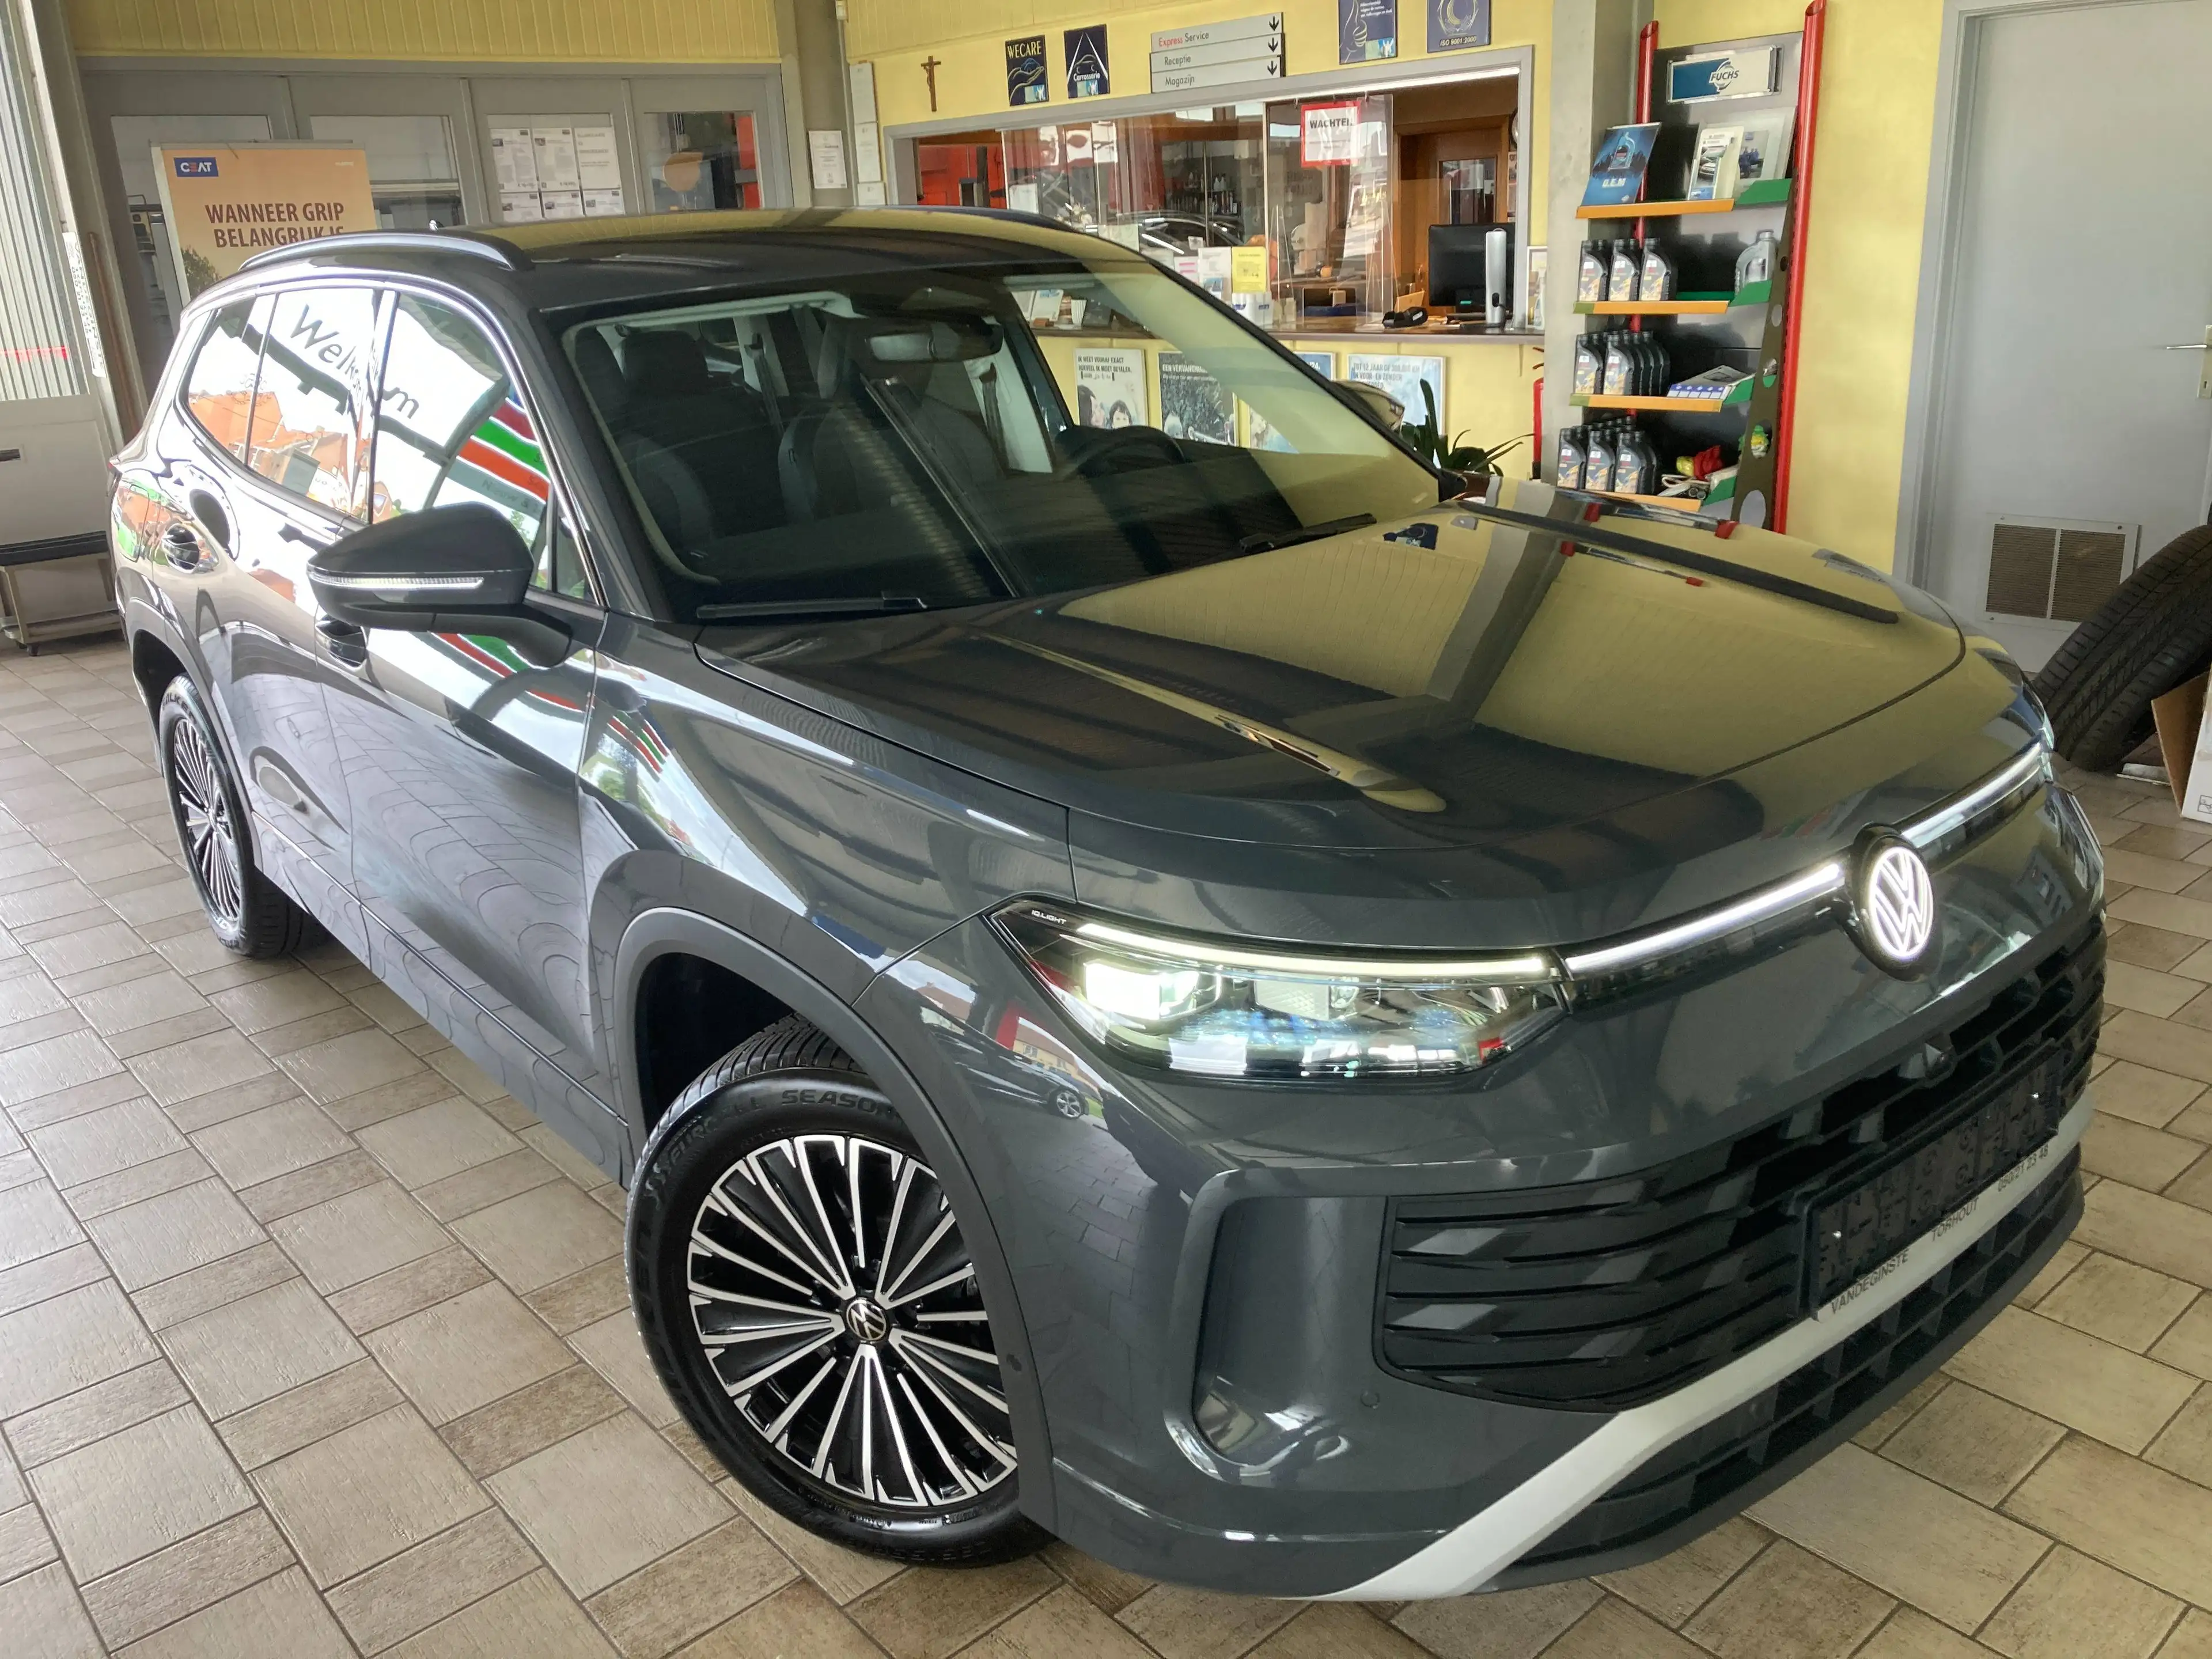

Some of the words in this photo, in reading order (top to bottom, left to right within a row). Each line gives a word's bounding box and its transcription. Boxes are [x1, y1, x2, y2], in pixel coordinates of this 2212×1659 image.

[1158, 36, 1183, 48] Express
[1185, 31, 1209, 42] Service
[1164, 54, 1191, 66] Receptie
[1073, 71, 1100, 82] Carrosserie
[1165, 74, 1195, 86] Magazijn
[1711, 70, 1740, 81] FUCHS
[205, 203, 299, 224] WANNEER
[302, 202, 344, 222] GRIP
[290, 303, 419, 419] Welkm
[1354, 362, 1362, 370] TOT
[1370, 363, 1382, 372] JAAR
[1031, 910, 1067, 925] IQ.LIGHT
[1931, 1197, 1980, 1241] TORHOUT
[1831, 1249, 1910, 1315] VANDEGINSTE
